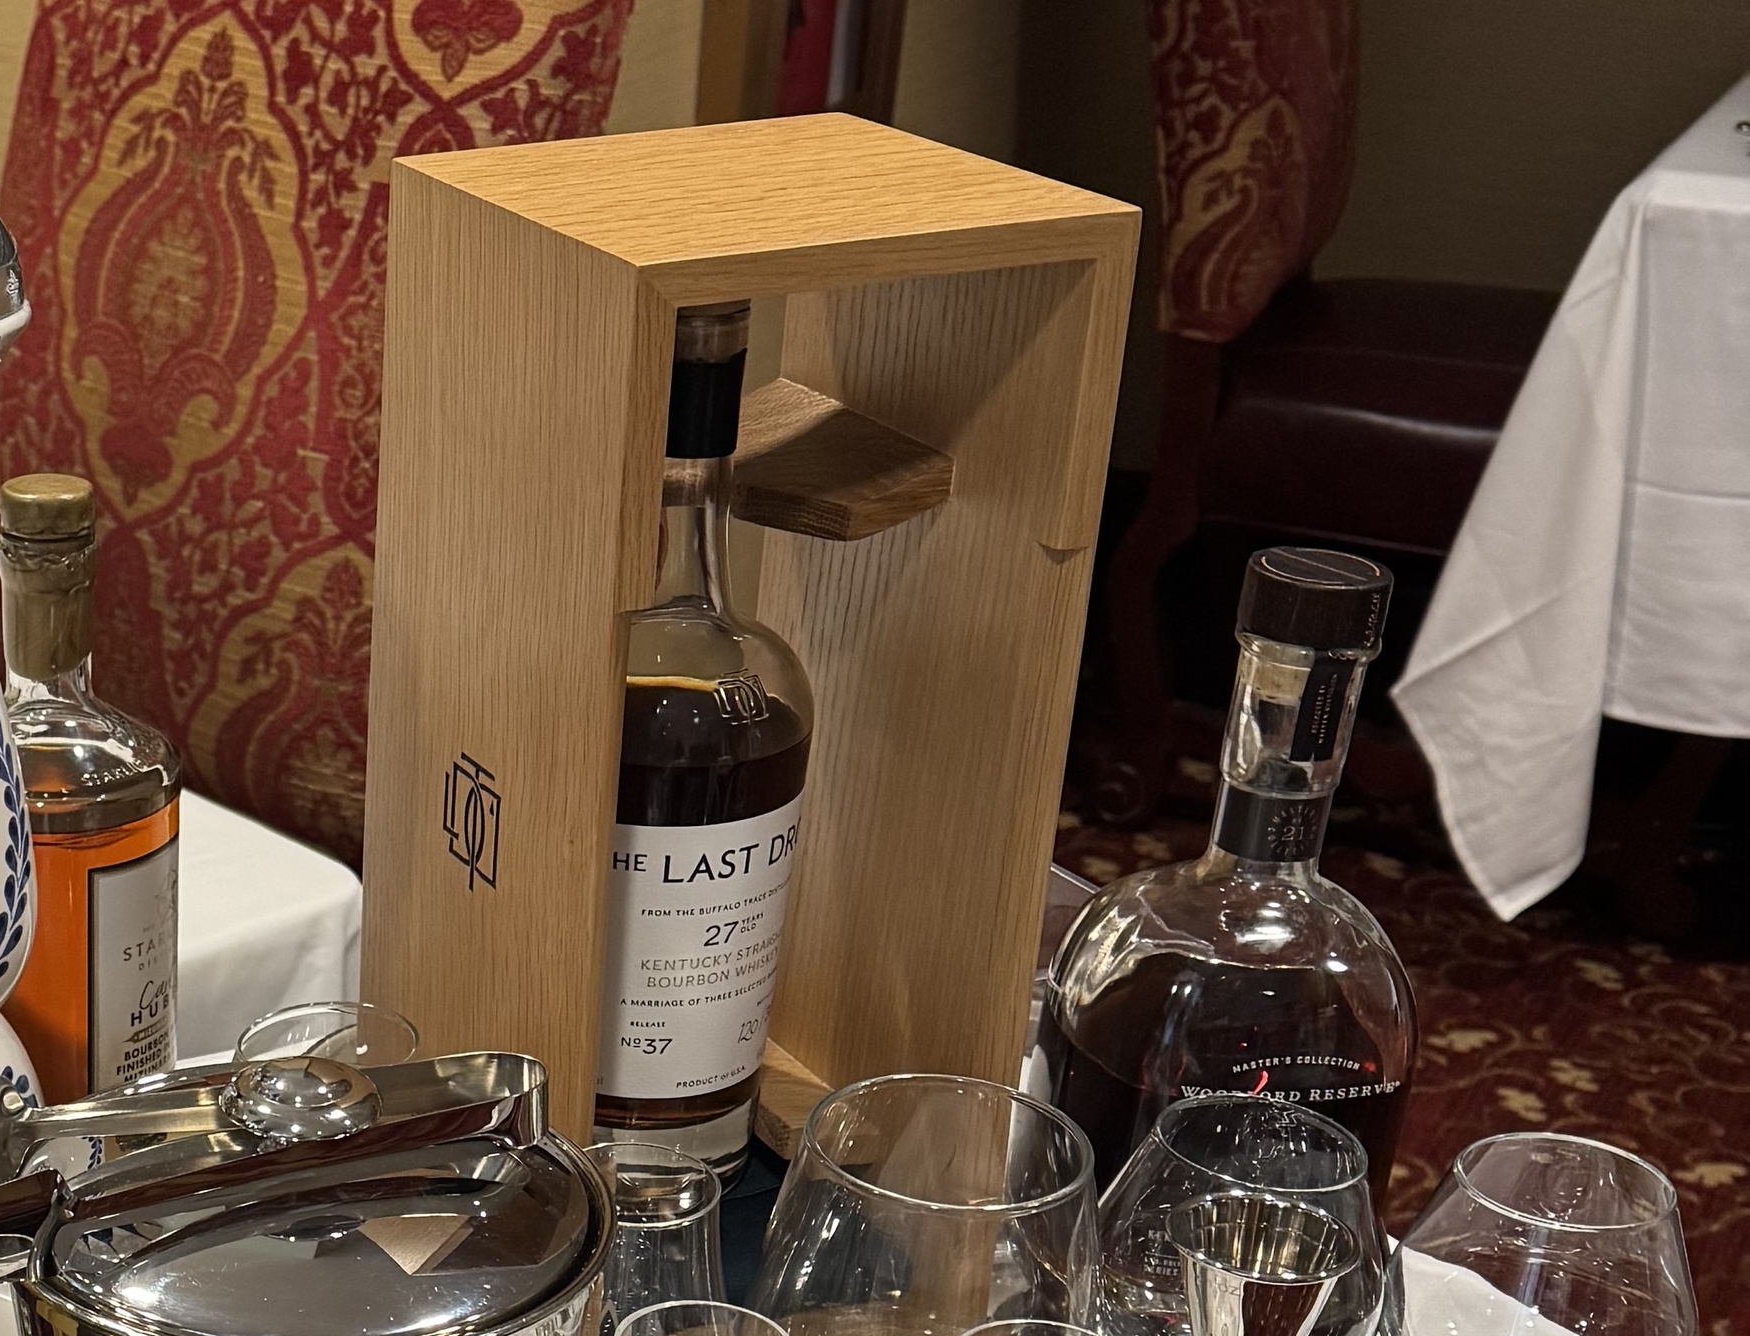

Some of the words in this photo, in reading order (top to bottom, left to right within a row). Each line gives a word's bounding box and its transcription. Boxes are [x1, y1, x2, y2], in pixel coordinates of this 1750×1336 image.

[1281, 825, 1304, 841] 21
[612, 851, 648, 872] HE
[662, 842, 760, 884] LAST
[768, 816, 802, 867] DR
[641, 908, 671, 917] FROM
[676, 907, 695, 917] THE
[699, 901, 741, 916] BUFFALO
[744, 891, 767, 907] TRACE
[740, 922, 757, 934] OLD
[741, 911, 764, 926] YEARS
[703, 920, 740, 947] 27
[640, 951, 732, 972] KENTUCKY
[646, 969, 730, 989] BOURBON
[619, 998, 627, 1006] A
[630, 999, 685, 1008] MARRIAGE
[688, 997, 701, 1006] OF
[704, 991, 732, 1005] THREE
[629, 1020, 666, 1028] RELEASE
[116, 1048, 162, 1076] FINISHED
[1232, 1056, 1292, 1074] MASTER'S
[1296, 1055, 1361, 1071] COLLECTION
[676, 1074, 719, 1089] PRODUCT
